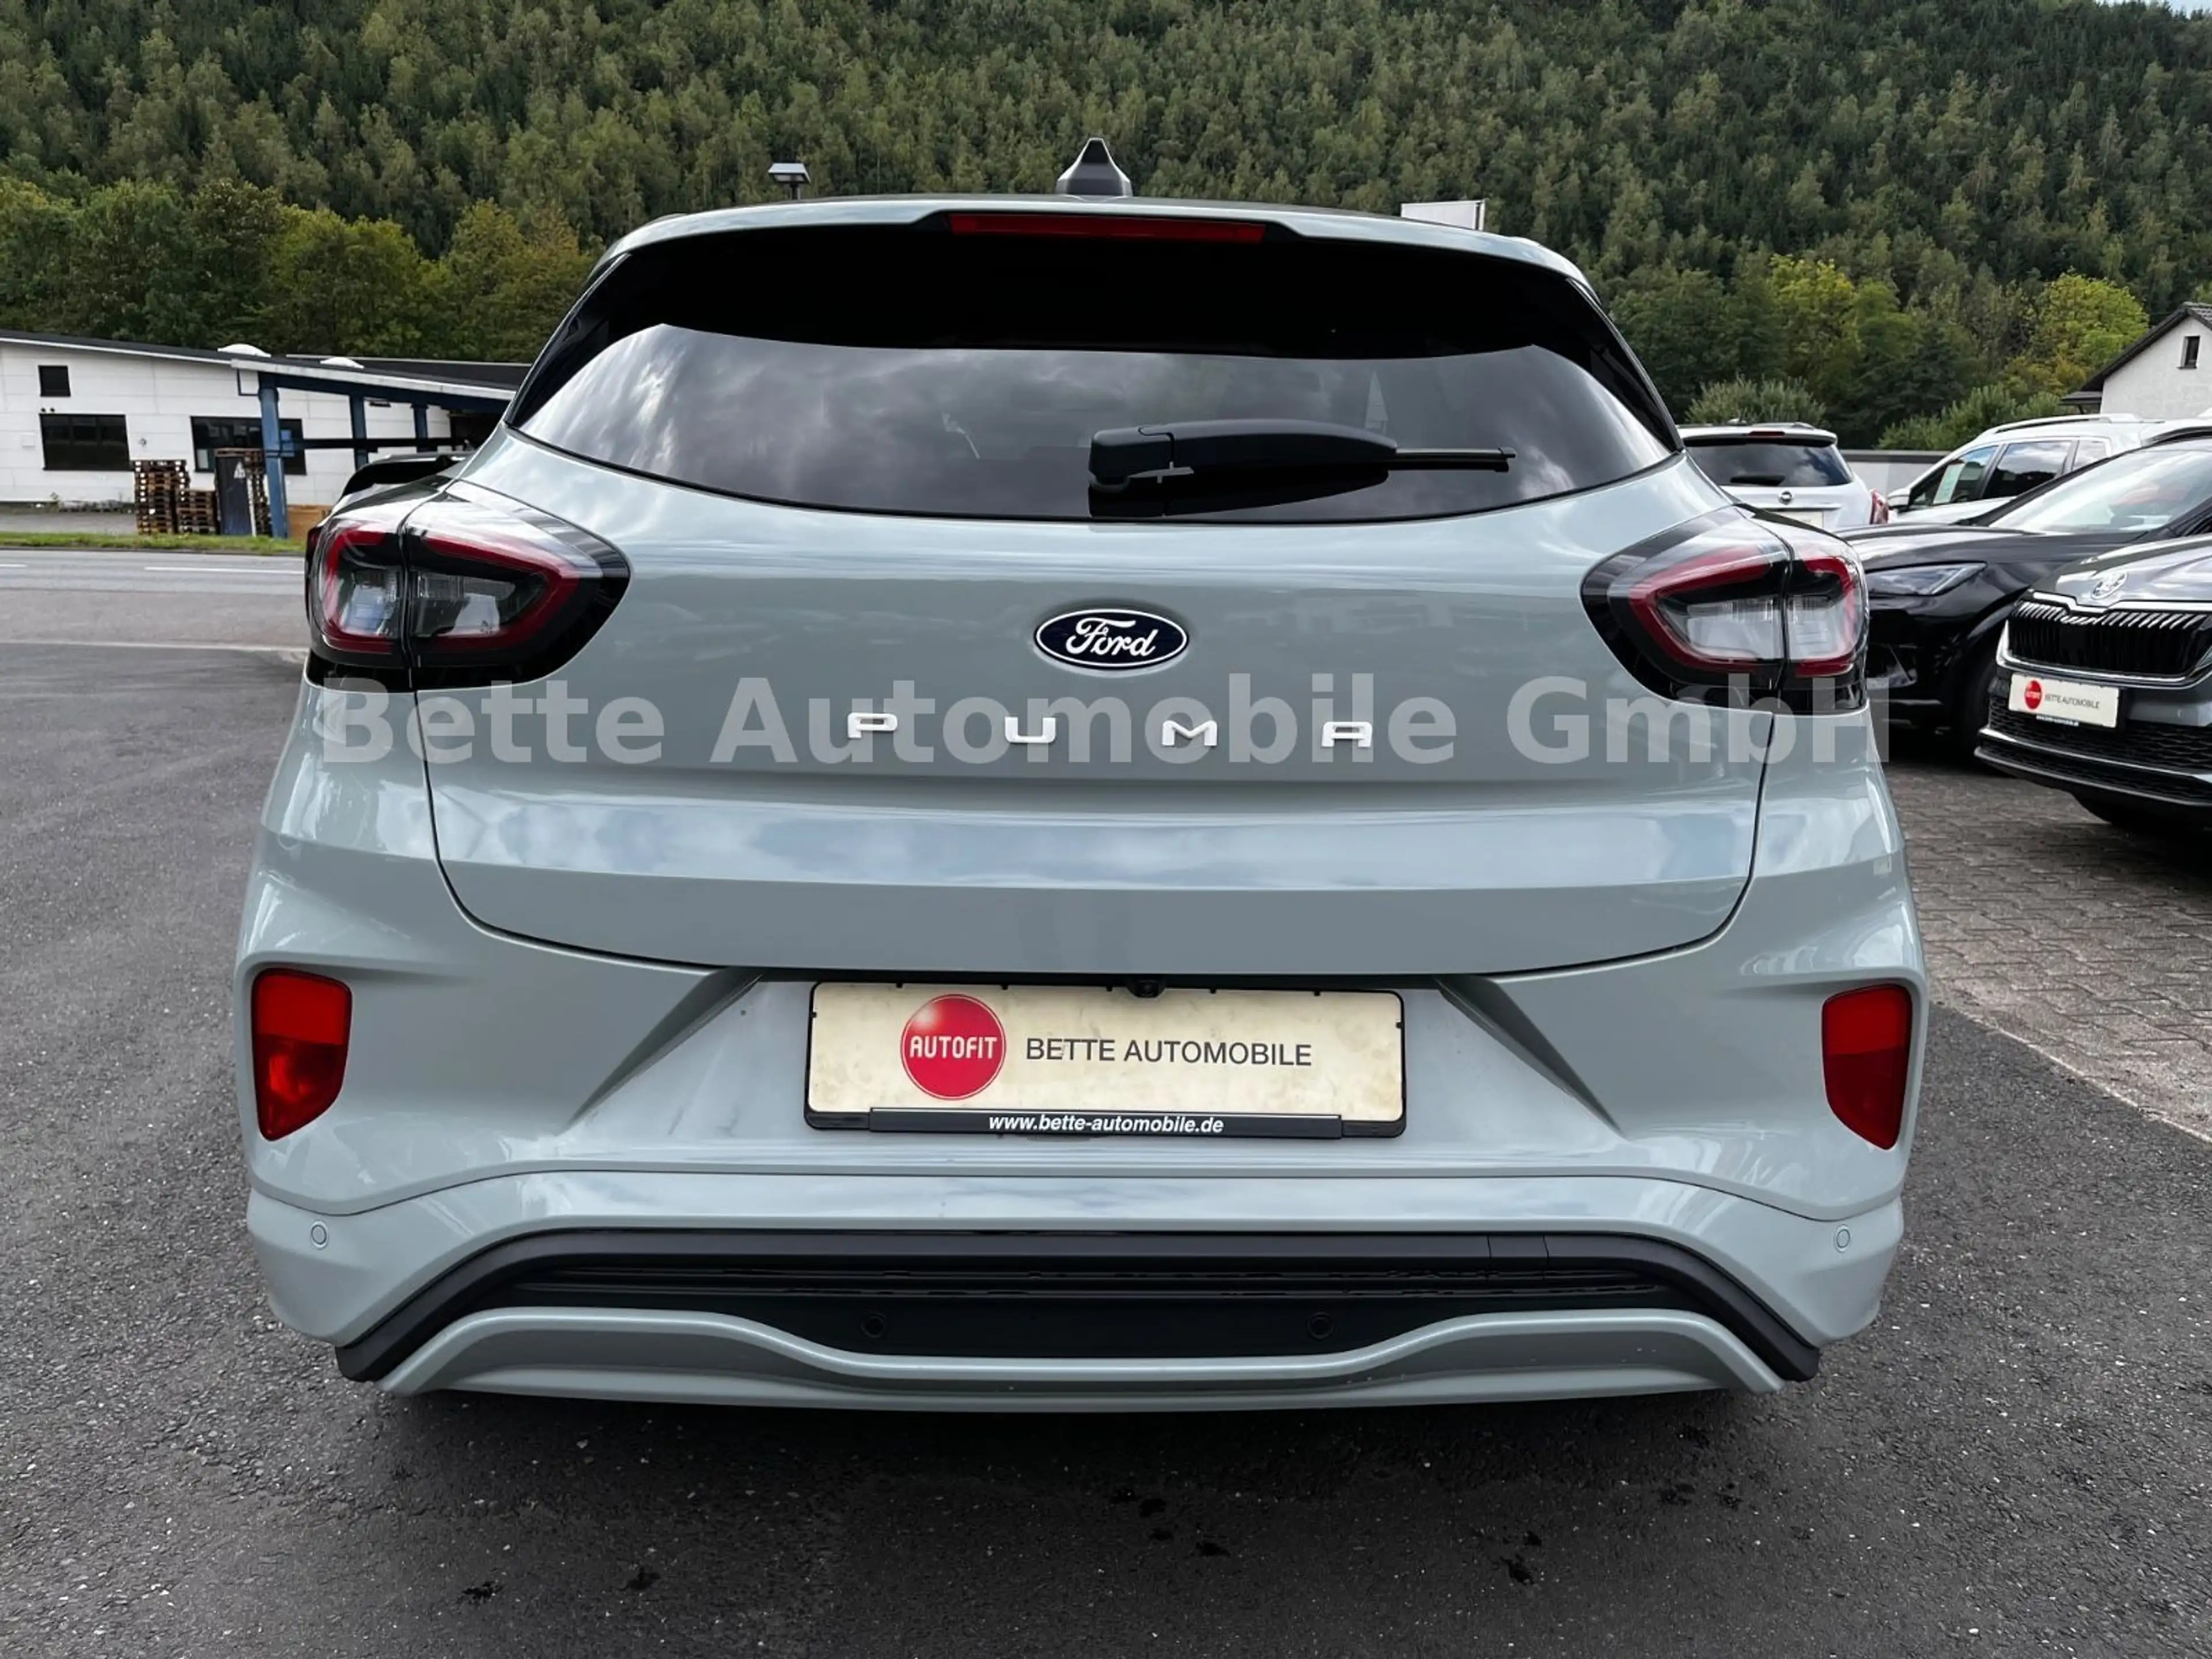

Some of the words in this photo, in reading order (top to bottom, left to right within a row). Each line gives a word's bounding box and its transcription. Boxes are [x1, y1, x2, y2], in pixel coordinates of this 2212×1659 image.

[1066, 618, 1158, 656] Ford
[847, 712, 1373, 748] PUMA
[910, 1035, 998, 1059] AUTOFIT
[1026, 1037, 1116, 1062] BETTE
[1123, 1040, 1312, 1066] AUTOMOBILE
[988, 1113, 1225, 1134] www.bette-automobile.de
